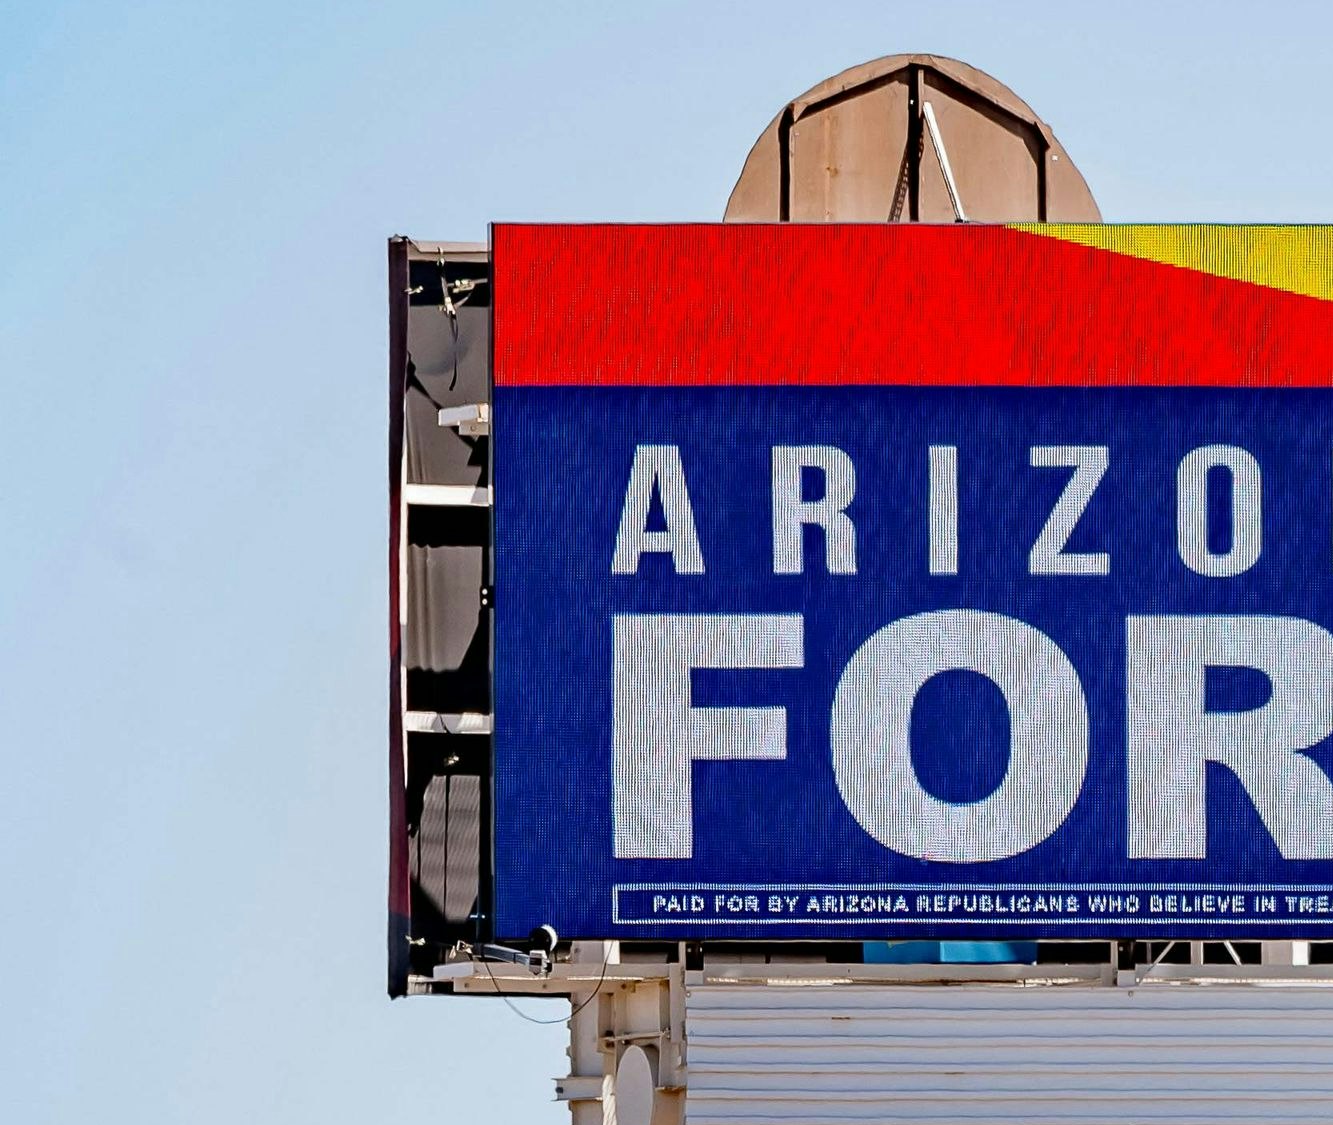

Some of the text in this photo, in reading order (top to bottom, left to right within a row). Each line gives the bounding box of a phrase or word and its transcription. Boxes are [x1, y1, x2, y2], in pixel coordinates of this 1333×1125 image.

[653, 895, 704, 912] PAID
[715, 895, 759, 912] FOR
[768, 895, 799, 912] BY
[807, 895, 909, 912] ARIZONA
[917, 895, 1079, 912] REPUBLICANS
[1088, 895, 1139, 912] WHO
[1150, 896, 1245, 913] BELIEVE
[1255, 896, 1276, 913] IN
